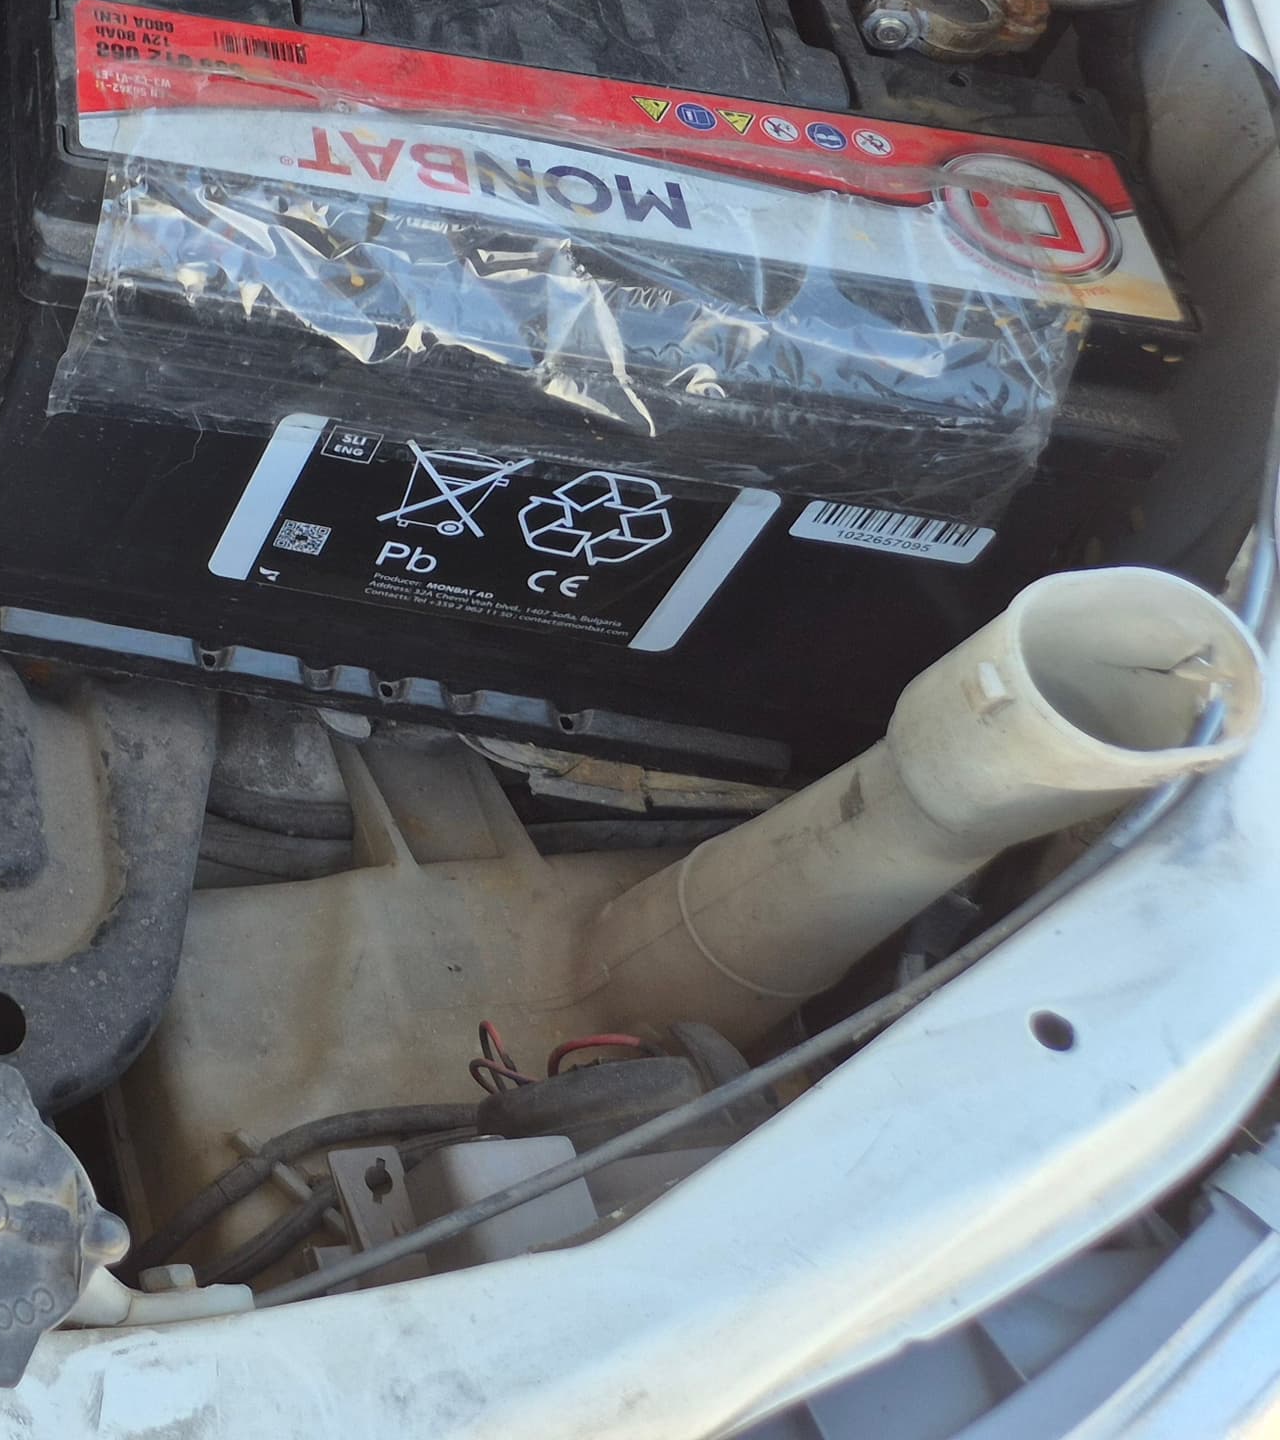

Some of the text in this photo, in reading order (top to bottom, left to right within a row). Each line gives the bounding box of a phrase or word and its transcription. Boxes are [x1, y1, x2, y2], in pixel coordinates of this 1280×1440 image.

[133, 15, 174, 34] 680A
[95, 25, 171, 48] 12V 80Ah
[297, 126, 692, 230] MONBAT
[333, 444, 365, 457] ENG
[341, 433, 368, 446] SLI
[837, 530, 933, 553] 1022657095
[375, 540, 437, 573] Pb
[364, 587, 412, 601] Contacts:
[373, 572, 494, 599] Producer: MONBAT AD
[369, 580, 412, 594] Address:
[579, 615, 622, 628] Bulgaria
